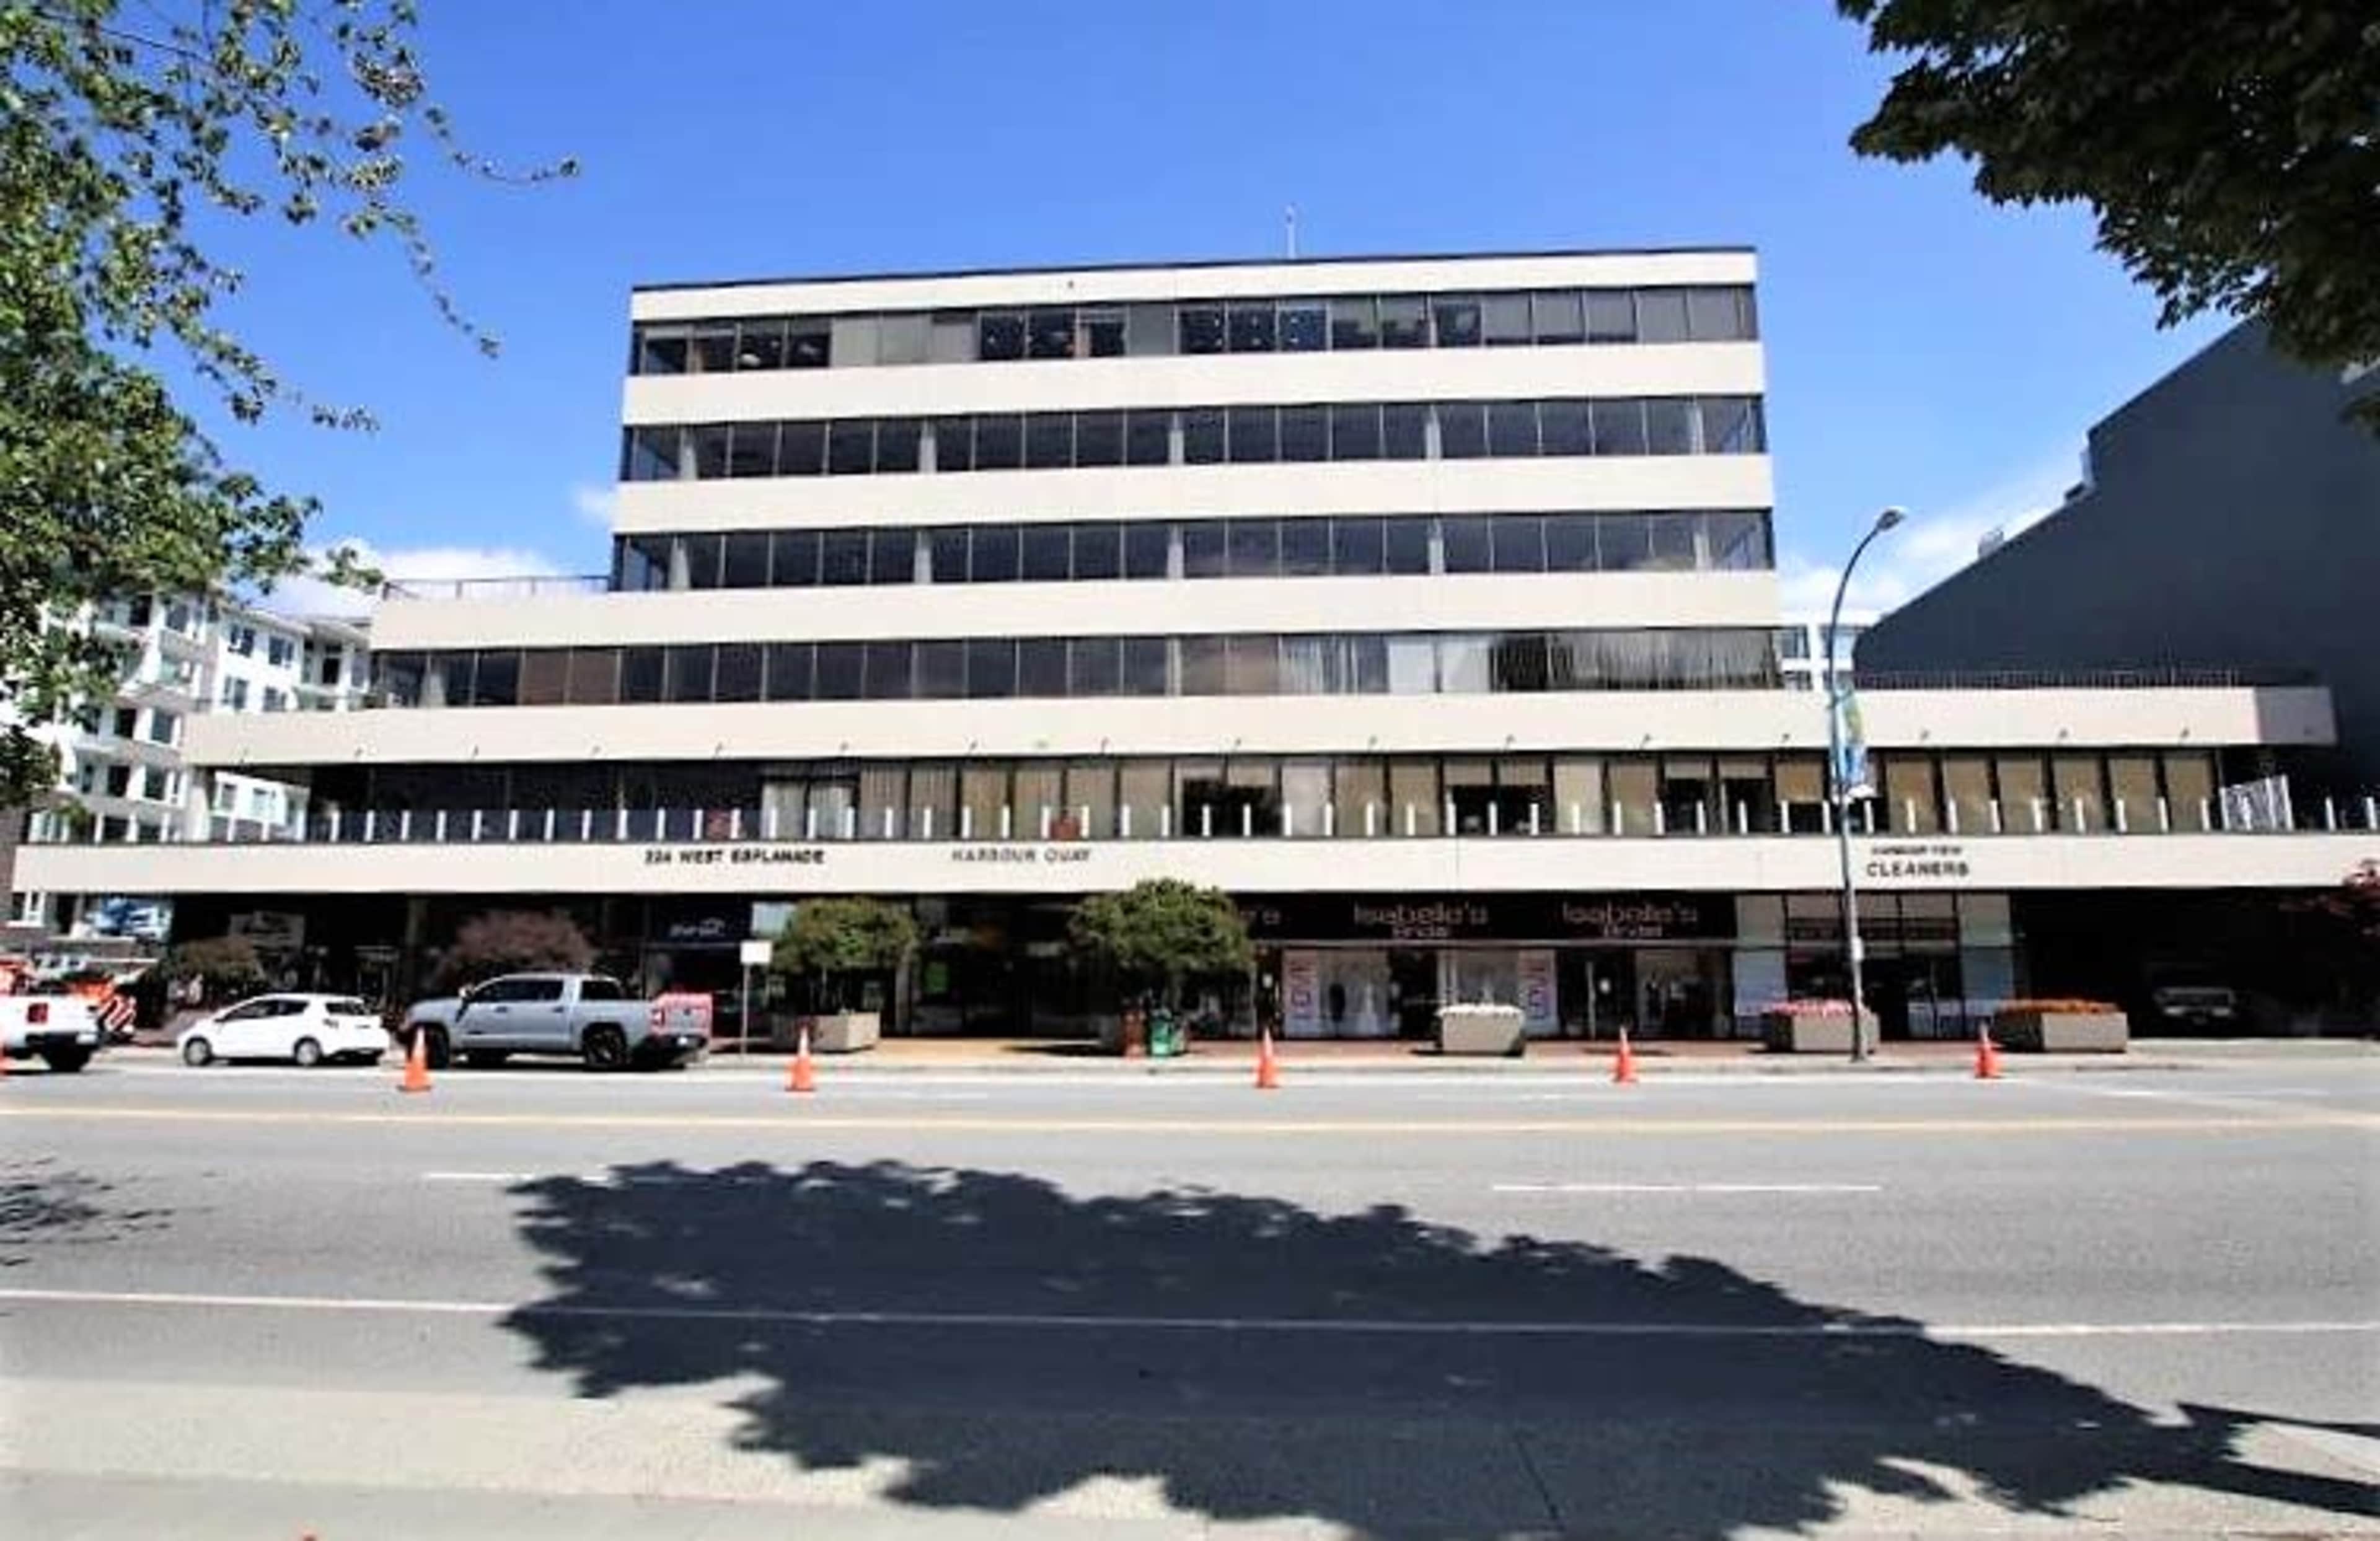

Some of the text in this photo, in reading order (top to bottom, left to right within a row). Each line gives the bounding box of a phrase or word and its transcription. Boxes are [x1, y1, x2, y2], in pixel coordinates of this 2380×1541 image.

[680, 850, 723, 864] WEST
[731, 849, 824, 863] ESPLANADE
[952, 848, 1090, 863] HARBOUR QUAY
[1867, 861, 1969, 877] CLEANERS
